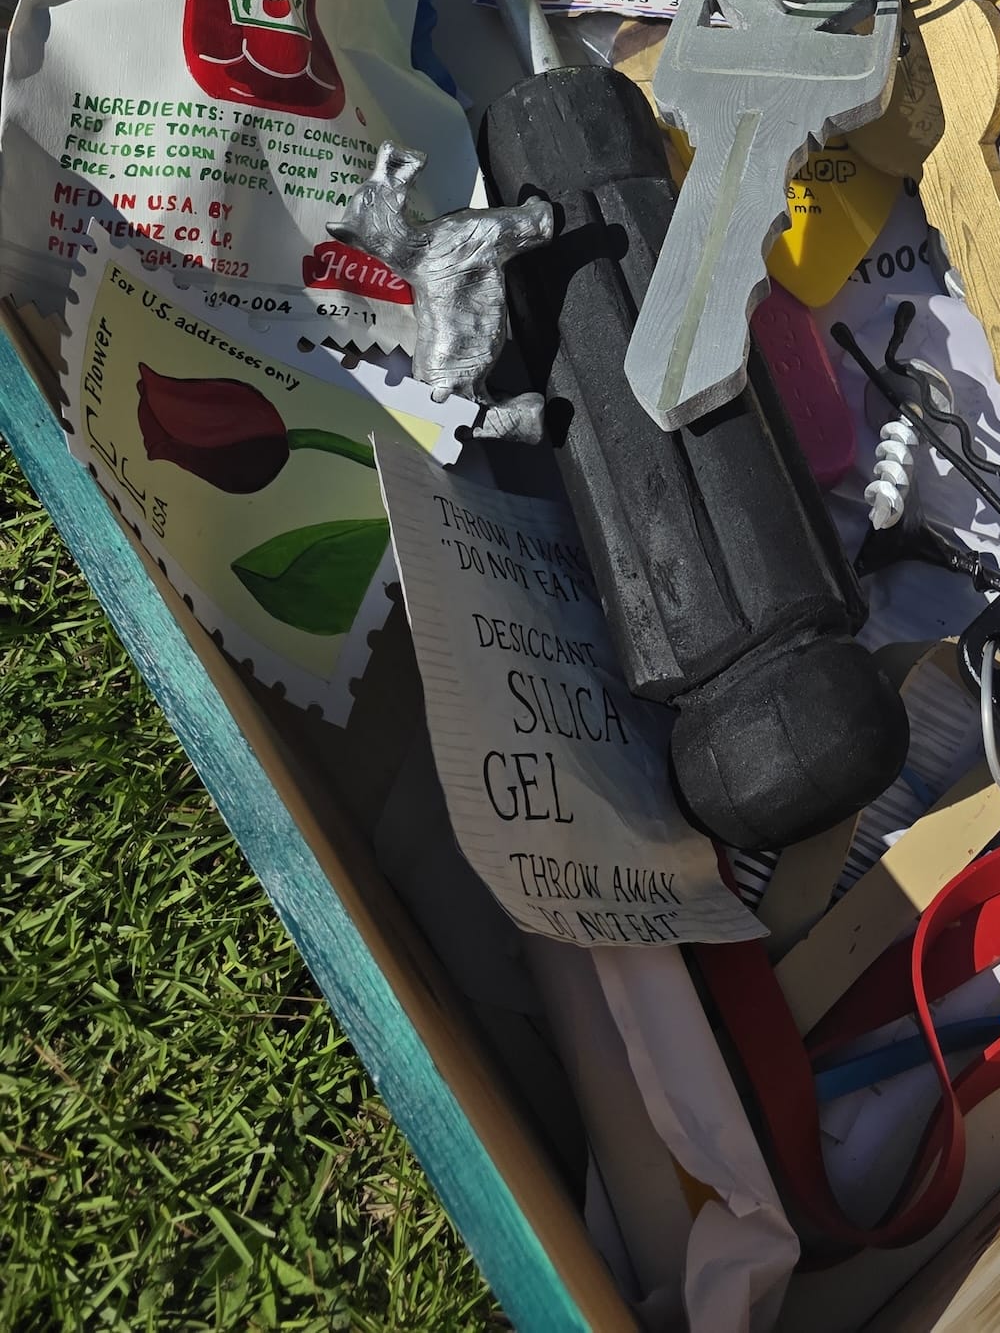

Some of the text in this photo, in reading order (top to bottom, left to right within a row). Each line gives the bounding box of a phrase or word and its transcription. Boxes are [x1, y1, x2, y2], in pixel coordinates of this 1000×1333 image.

[72, 91, 296, 137] INGREDIENTS: TOMATO
[64, 133, 319, 180] FRUCTOSE CORN CORN
[70, 113, 104, 134] RED
[114, 121, 156, 138] RIPE
[267, 138, 335, 162] DISTILLED
[59, 154, 273, 196] SPICE, ONION POWDER,
[54, 182, 233, 222] MFD IN U.S.A. BY
[794, 204, 822, 215] mm
[173, 226, 232, 251] CO. LP.
[182, 253, 250, 279] PA 15222
[312, 250, 405, 292] Heinz
[108, 266, 301, 393] For U.S. addresses only
[315, 303, 378, 326] 627-11
[84, 315, 114, 405] Flower
[150, 495, 169, 539] USA
[433, 495, 512, 550] THROW
[486, 551, 530, 590] NOT
[472, 613, 599, 668] DESICCANT
[507, 670, 630, 745] SILICA
[483, 751, 575, 825] GEL
[509, 853, 682, 906] THROW AWAY
[578, 909, 632, 942] NOT
